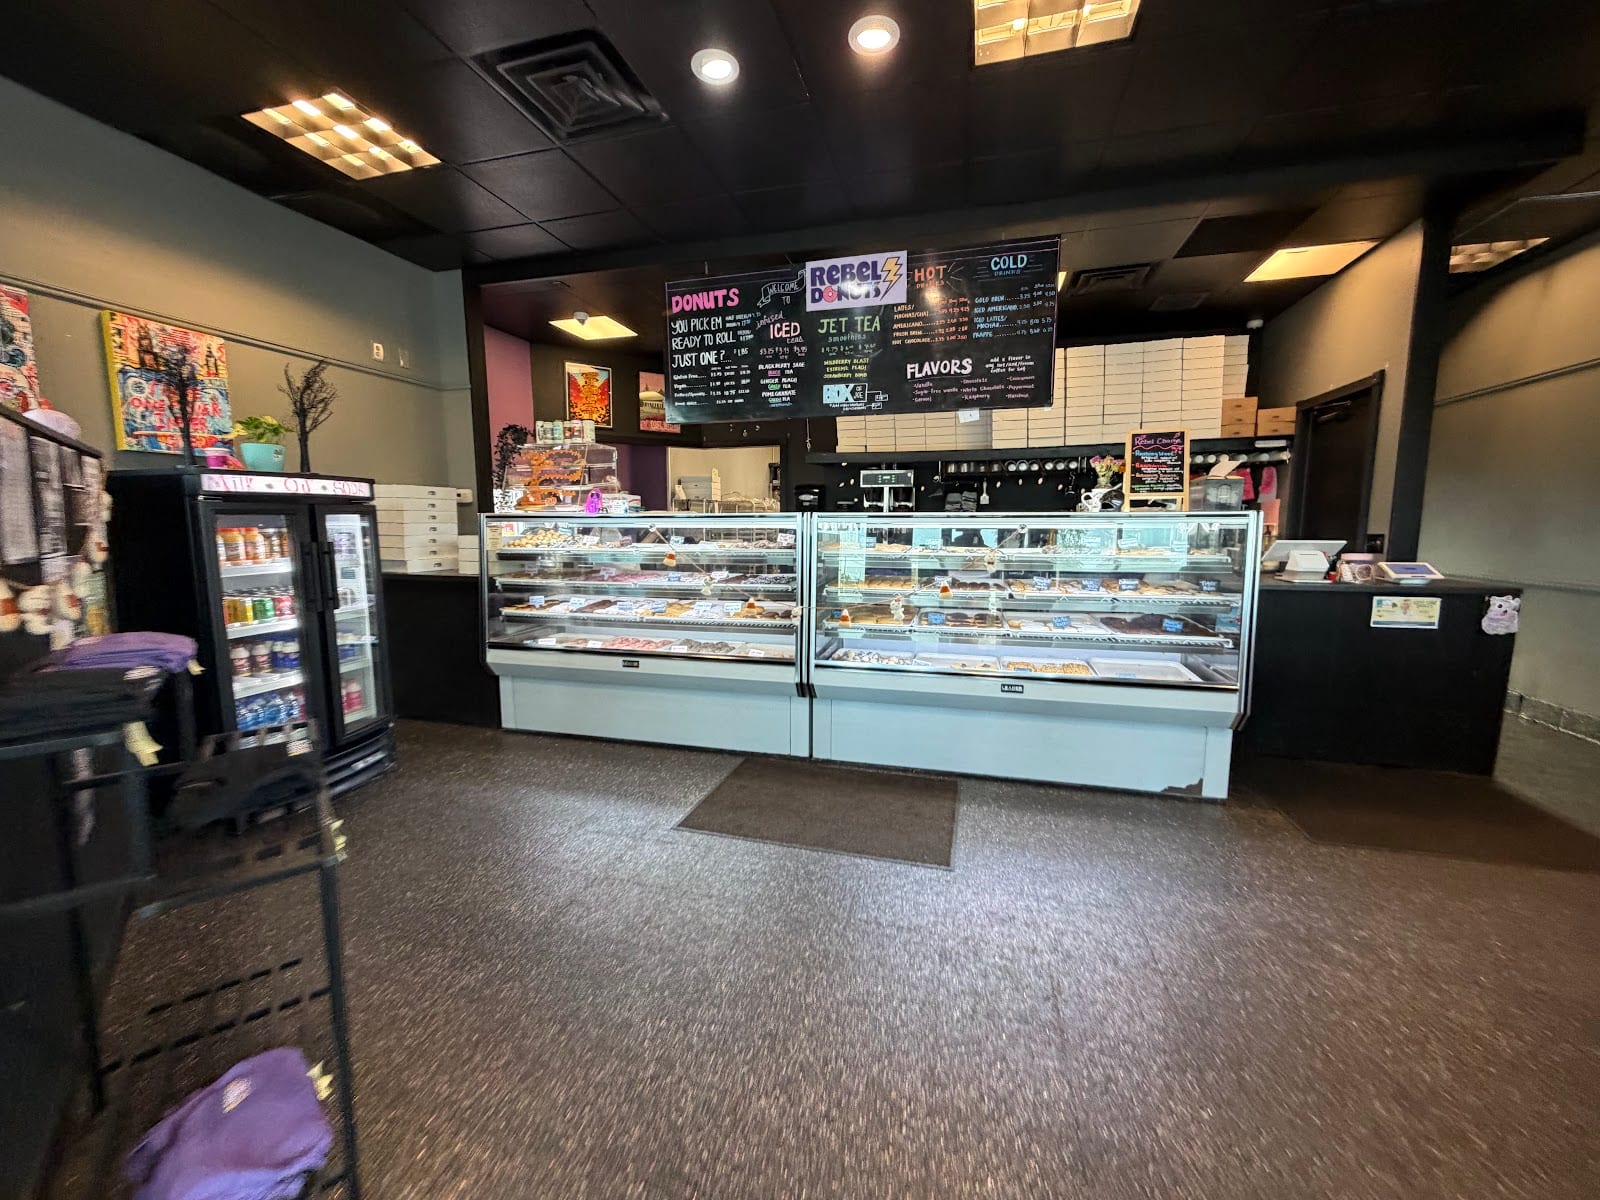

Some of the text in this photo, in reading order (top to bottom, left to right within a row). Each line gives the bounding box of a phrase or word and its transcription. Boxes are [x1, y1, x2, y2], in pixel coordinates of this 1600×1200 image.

[991, 254, 1028, 271] COLD
[914, 265, 947, 282] HOT
[767, 281, 799, 294] WELCOME
[672, 288, 739, 314] DONUTS
[780, 296, 791, 305] TO
[975, 296, 989, 304] COLD
[671, 316, 722, 335] YOU PICK EM
[770, 321, 801, 339] ICED
[818, 315, 880, 334] JET TEA
[672, 335, 702, 350] READY
[703, 334, 714, 346] TO
[716, 330, 737, 345] ROLL
[672, 352, 698, 368] JUST
[906, 358, 973, 379] FLAVORS
[823, 384, 855, 404] BOX
